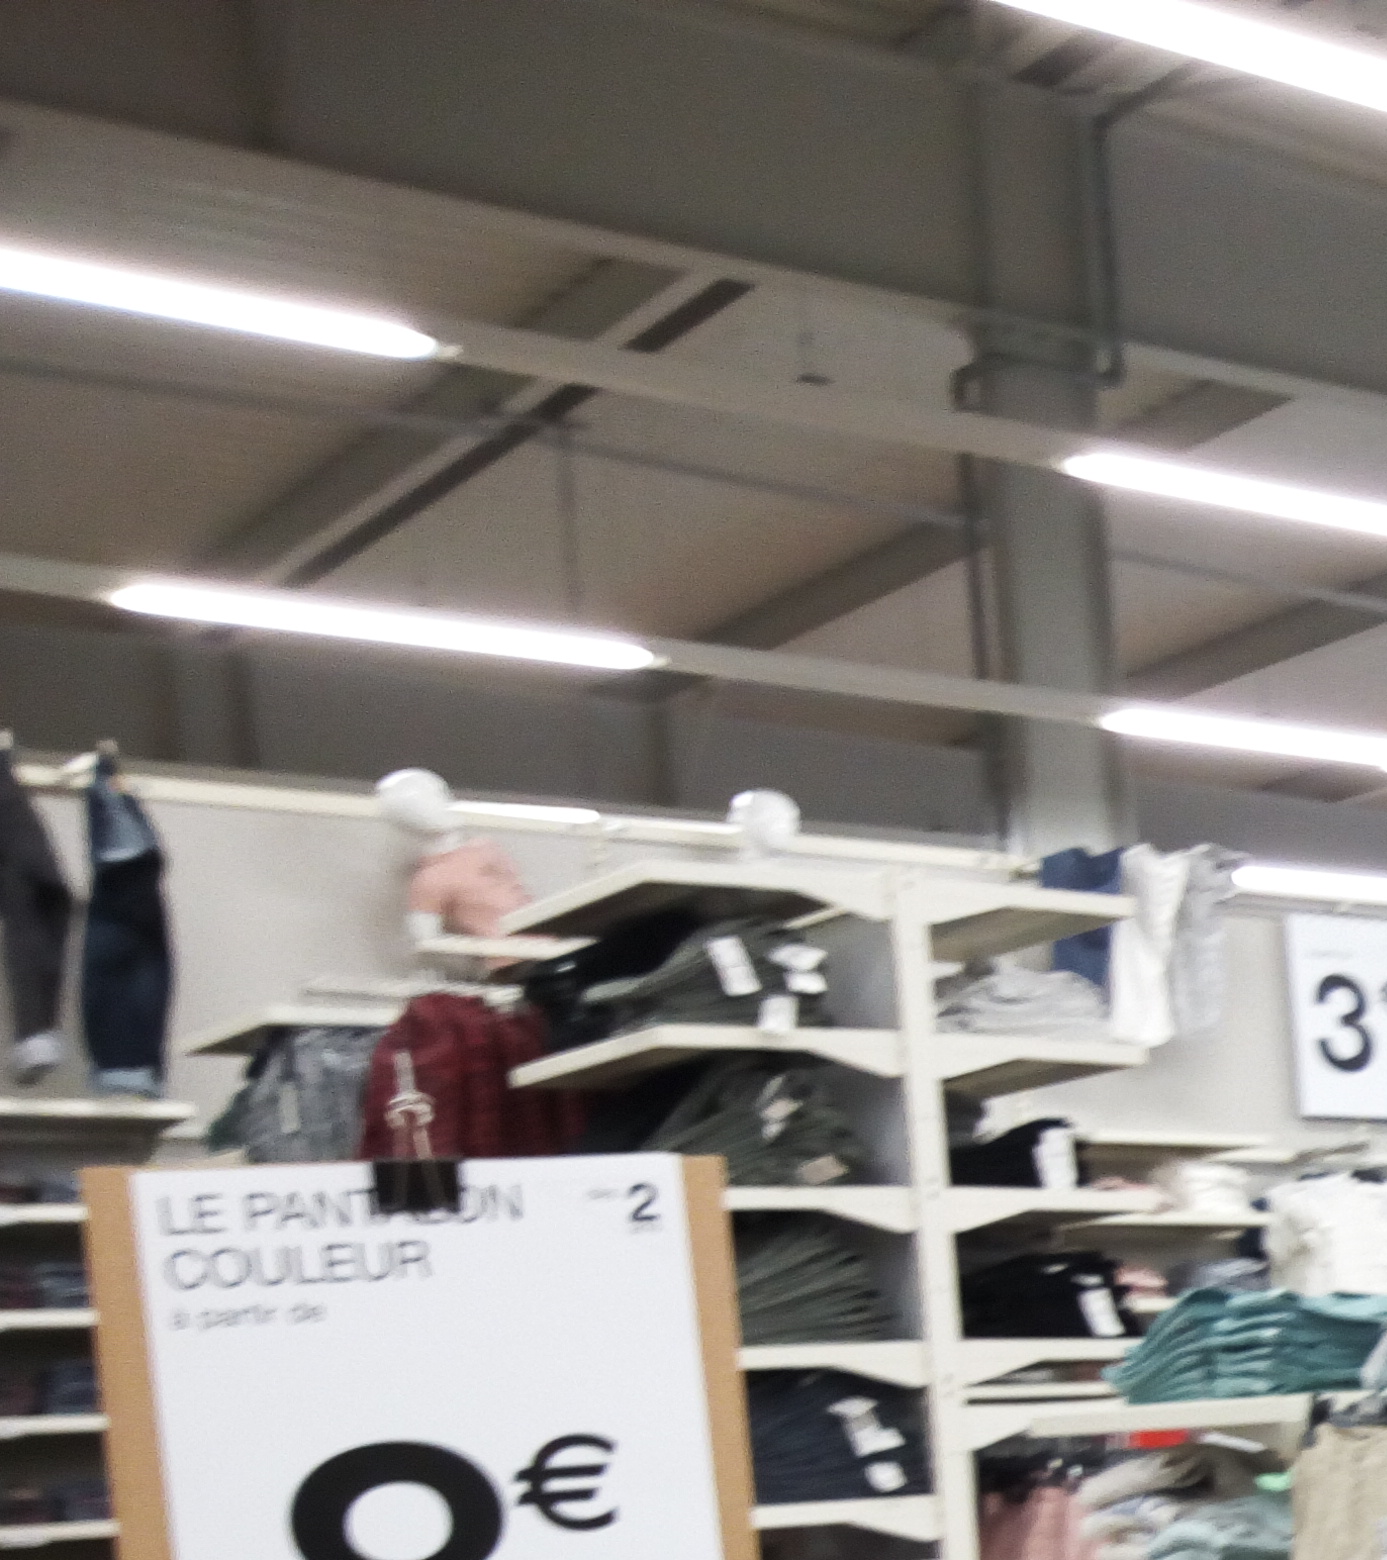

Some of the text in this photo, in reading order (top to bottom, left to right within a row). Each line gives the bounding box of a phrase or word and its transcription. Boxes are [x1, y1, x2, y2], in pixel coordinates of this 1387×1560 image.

[158, 1182, 523, 1236] LE PANTON
[629, 1182, 660, 1222] 2
[163, 1239, 433, 1290] COULEUR
